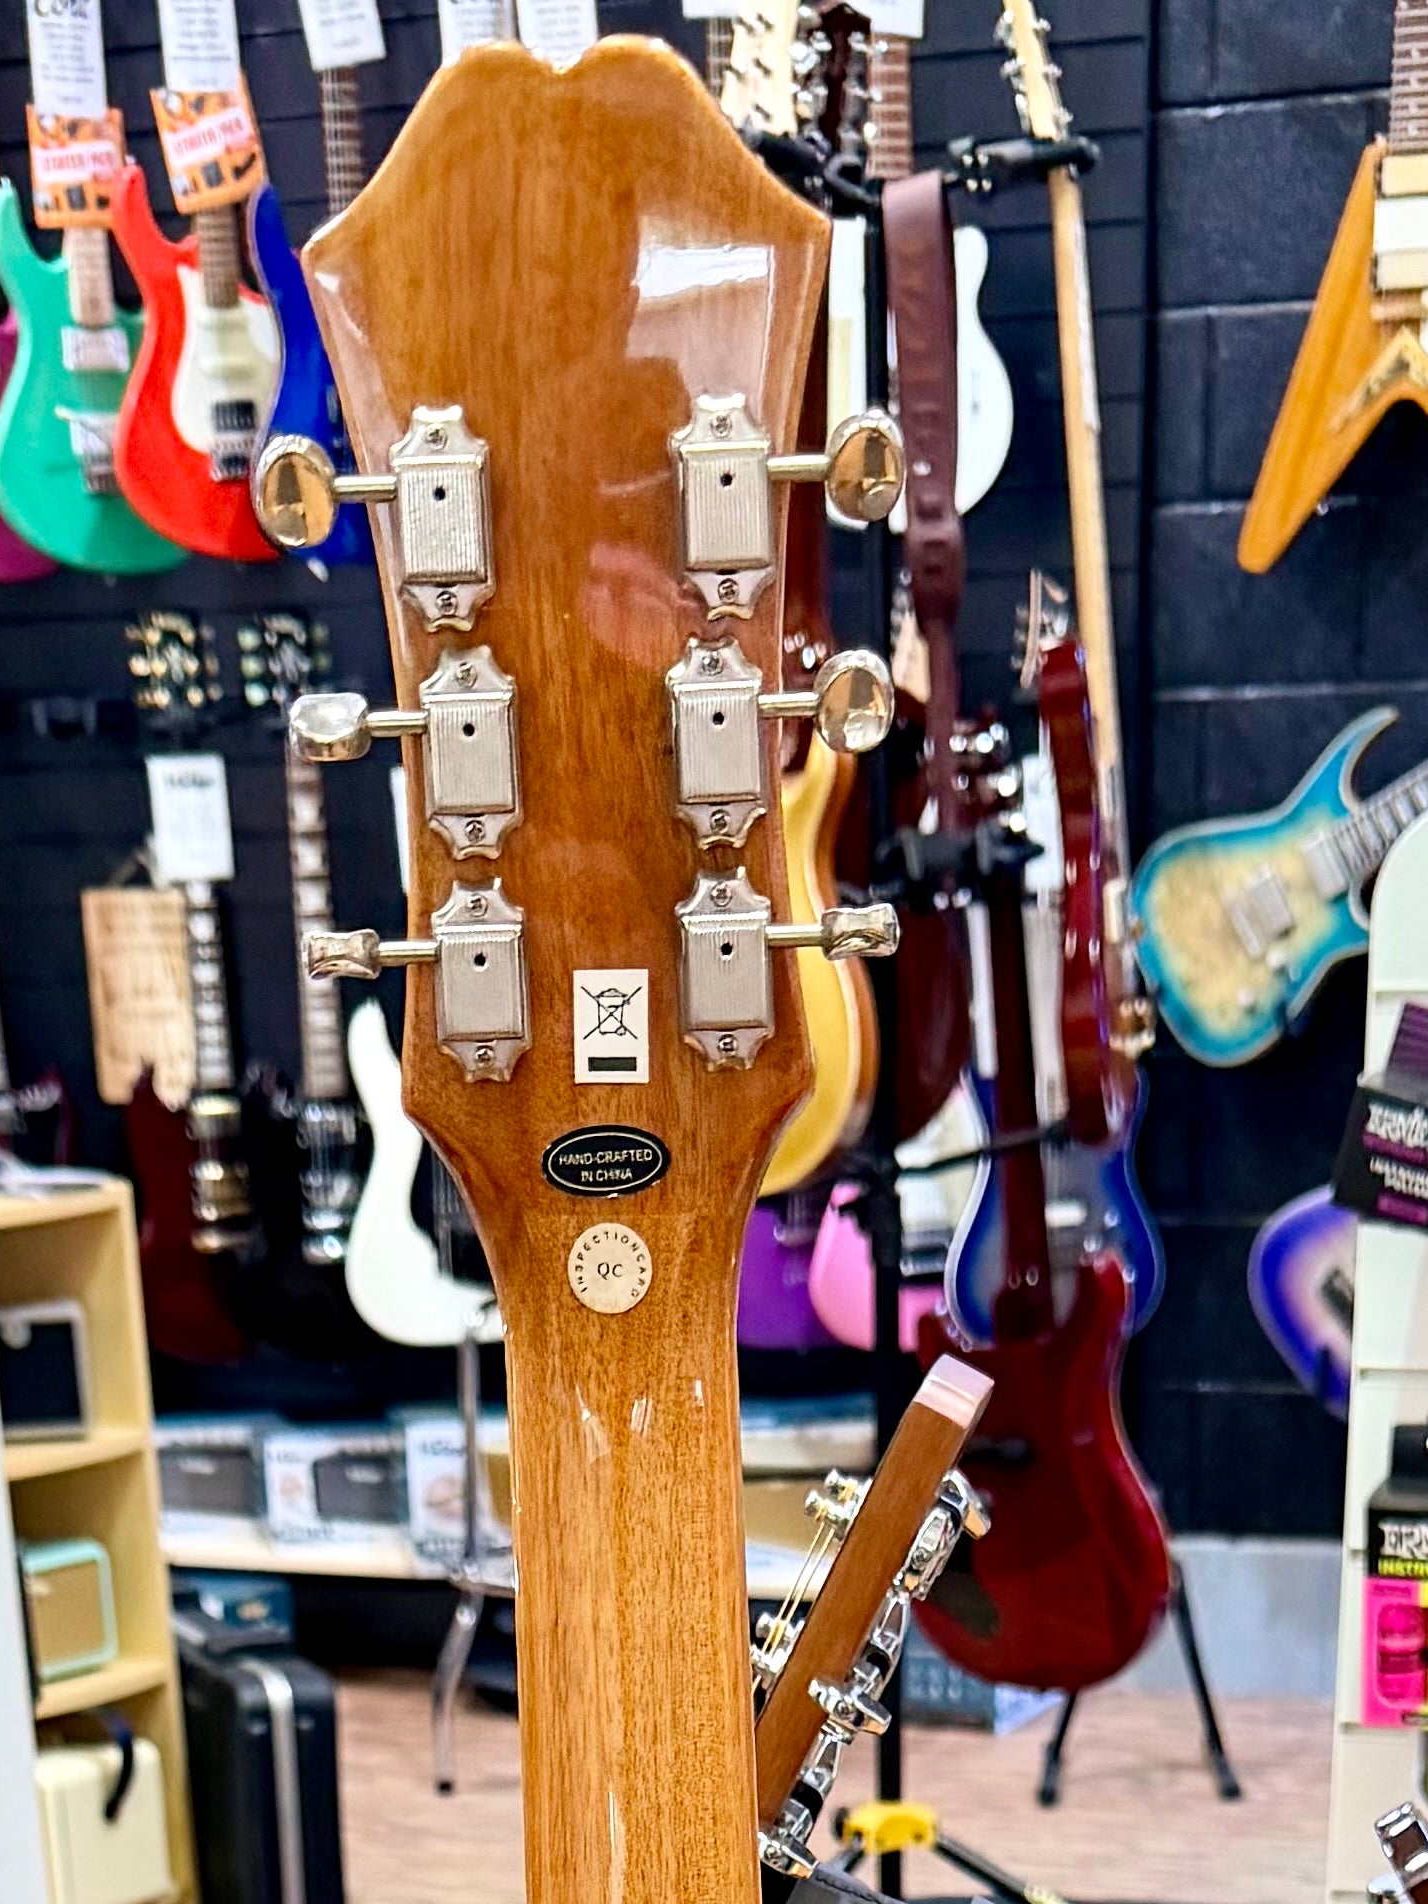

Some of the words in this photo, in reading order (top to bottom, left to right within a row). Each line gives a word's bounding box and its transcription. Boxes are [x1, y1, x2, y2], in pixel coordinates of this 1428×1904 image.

[558, 1149, 653, 1167] HAND-CRAFTED
[580, 1169, 594, 1183] IN
[595, 1168, 634, 1182] CHINA
[597, 1262, 623, 1281] QC
